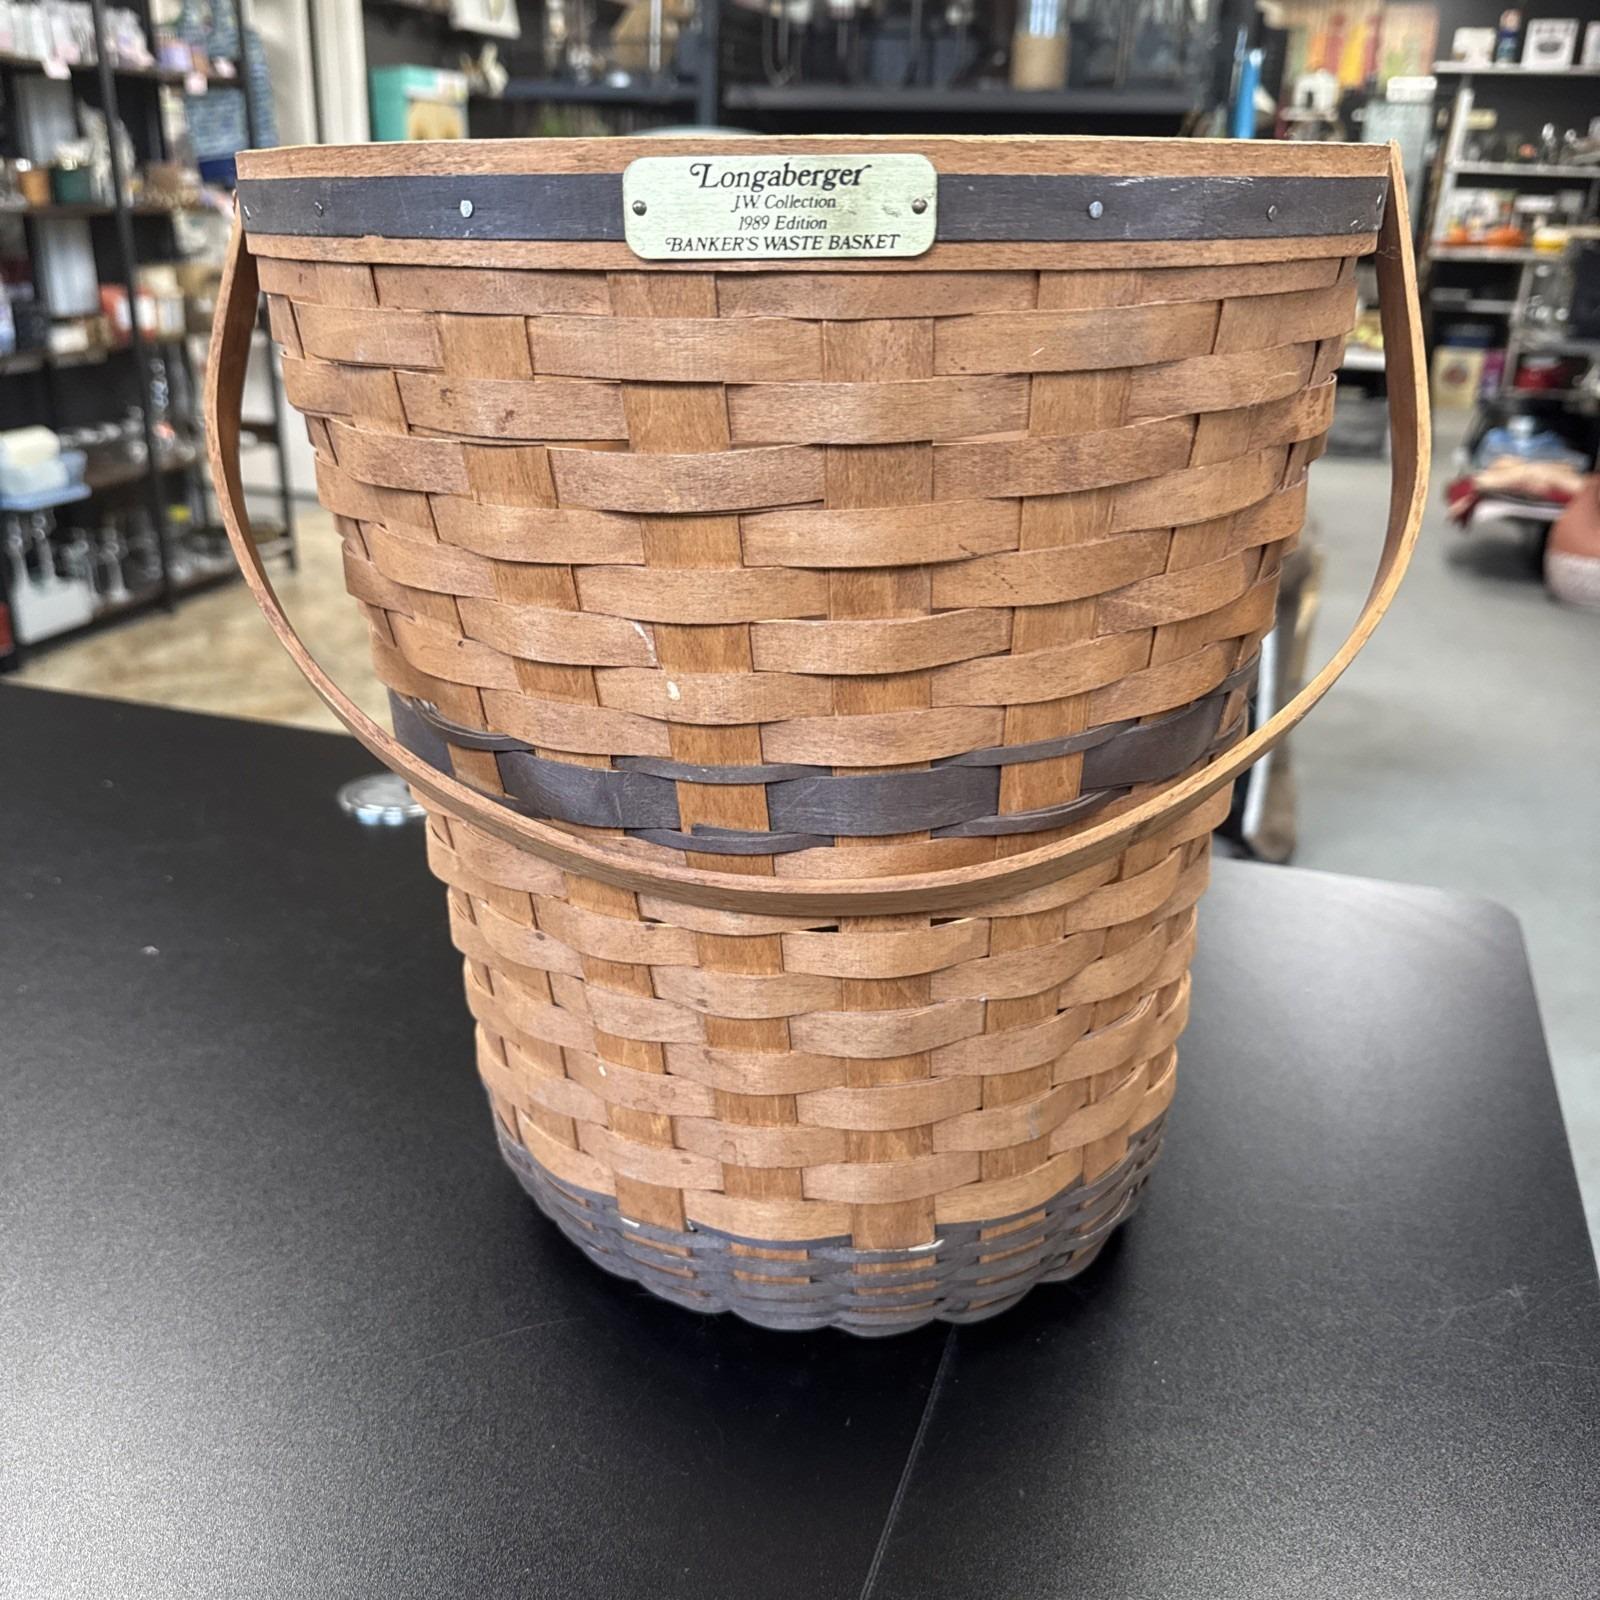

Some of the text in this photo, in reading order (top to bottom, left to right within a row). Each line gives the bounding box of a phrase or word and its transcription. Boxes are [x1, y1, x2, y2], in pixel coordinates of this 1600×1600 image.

[690, 163, 872, 191] Longaberger
[764, 194, 836, 210] Collection
[739, 215, 827, 230] 1989 Edition
[666, 234, 900, 252] BANKER'S WASTE BASKET
